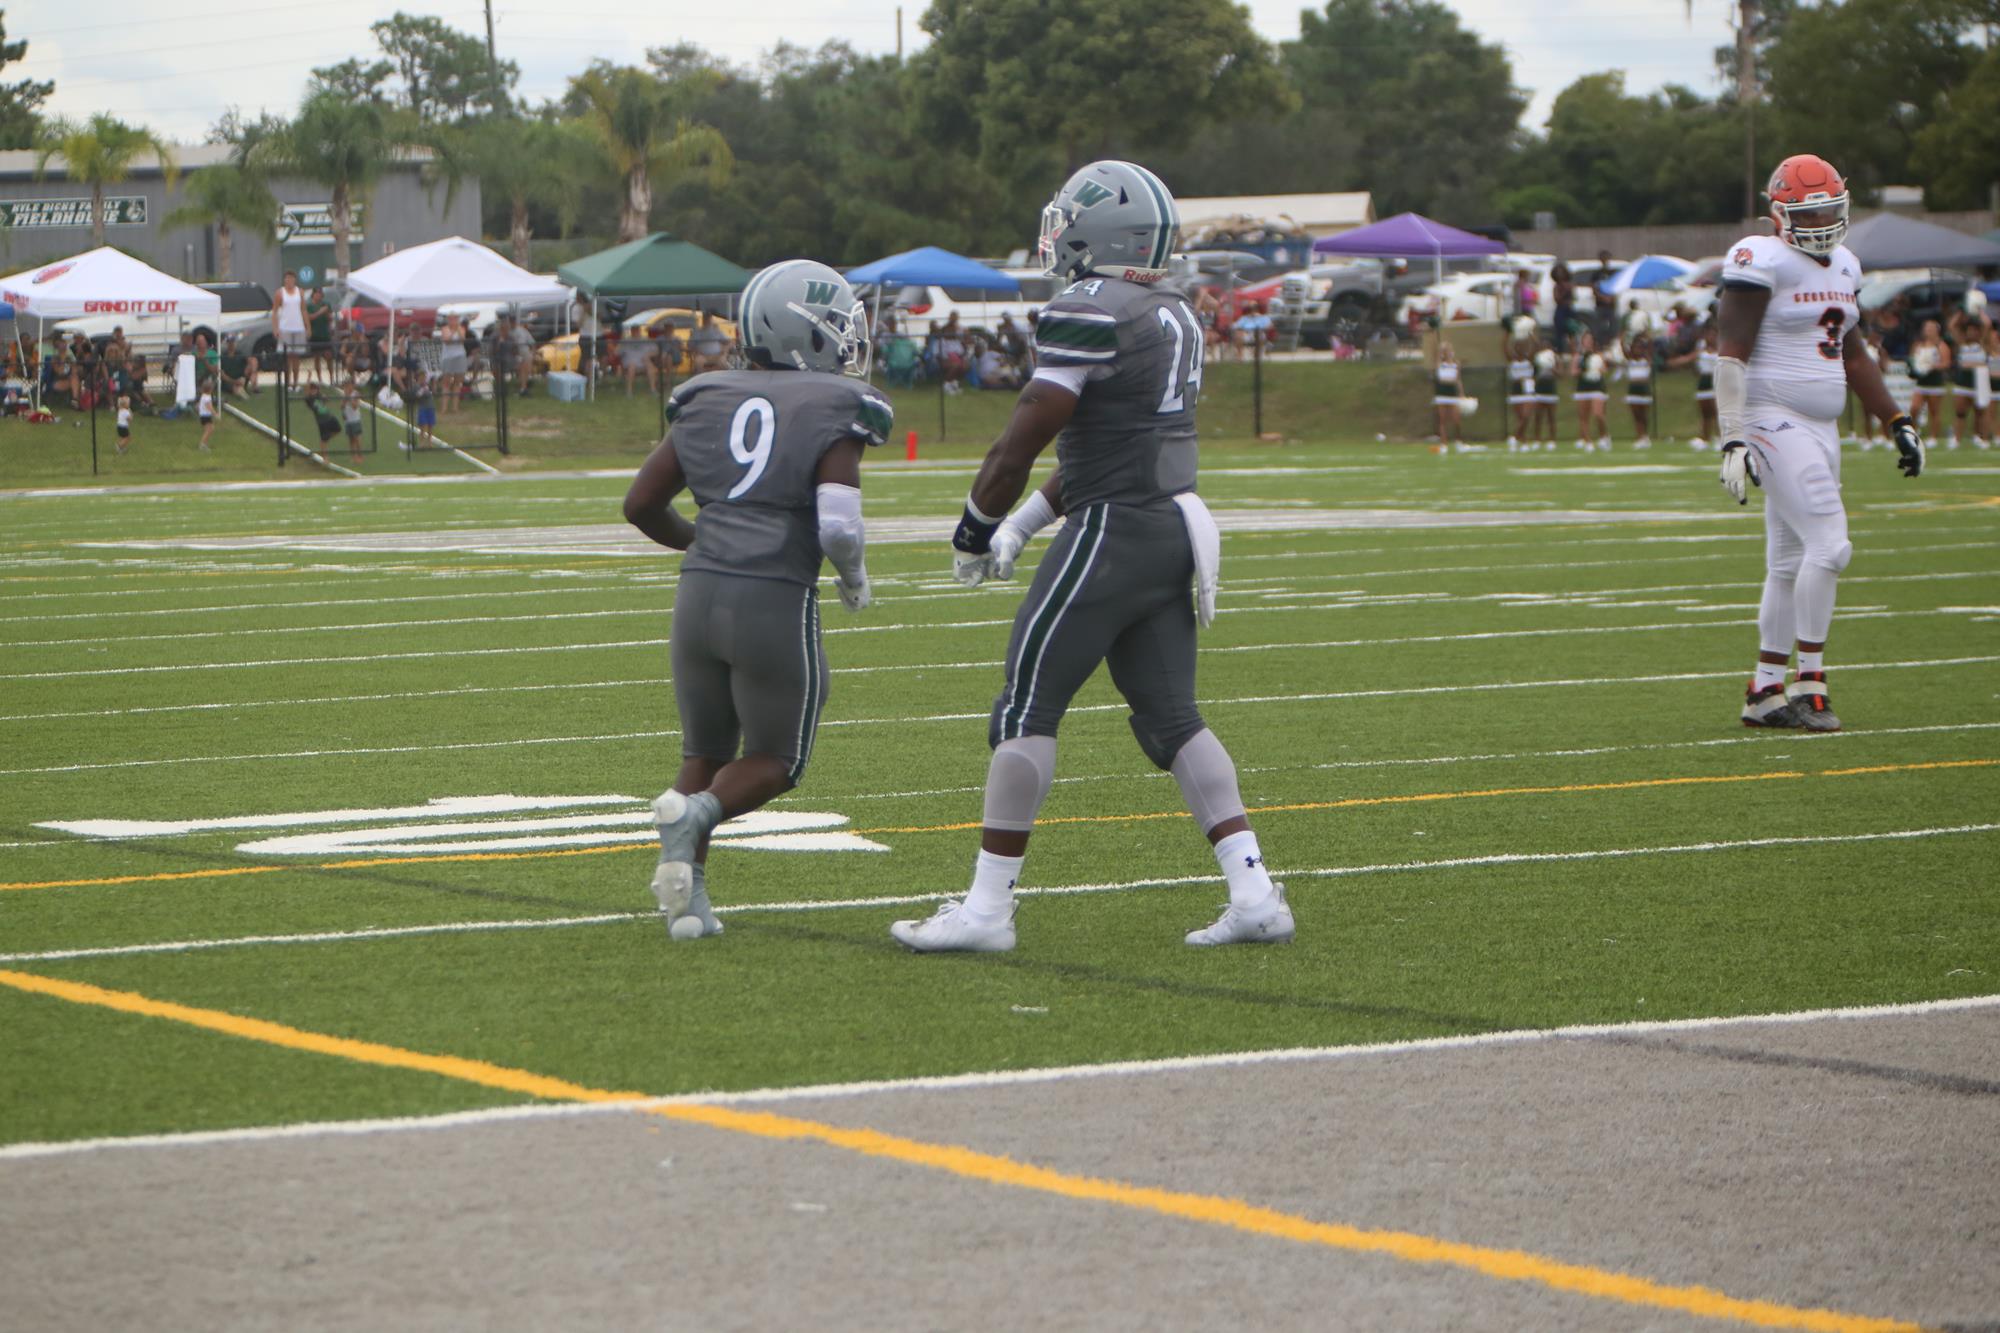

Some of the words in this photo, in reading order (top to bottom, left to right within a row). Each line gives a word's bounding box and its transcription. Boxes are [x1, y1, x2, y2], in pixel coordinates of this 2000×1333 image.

[12, 210, 120, 226] FIELDHOUE
[78, 200, 121, 210] FAILY
[802, 279, 841, 306] W
[84, 301, 128, 313] GRIND
[131, 301, 145, 313] IT
[148, 301, 178, 313] OUT
[1818, 307, 1845, 359] 3
[1156, 300, 1204, 414] 24
[727, 396, 776, 500] 9
